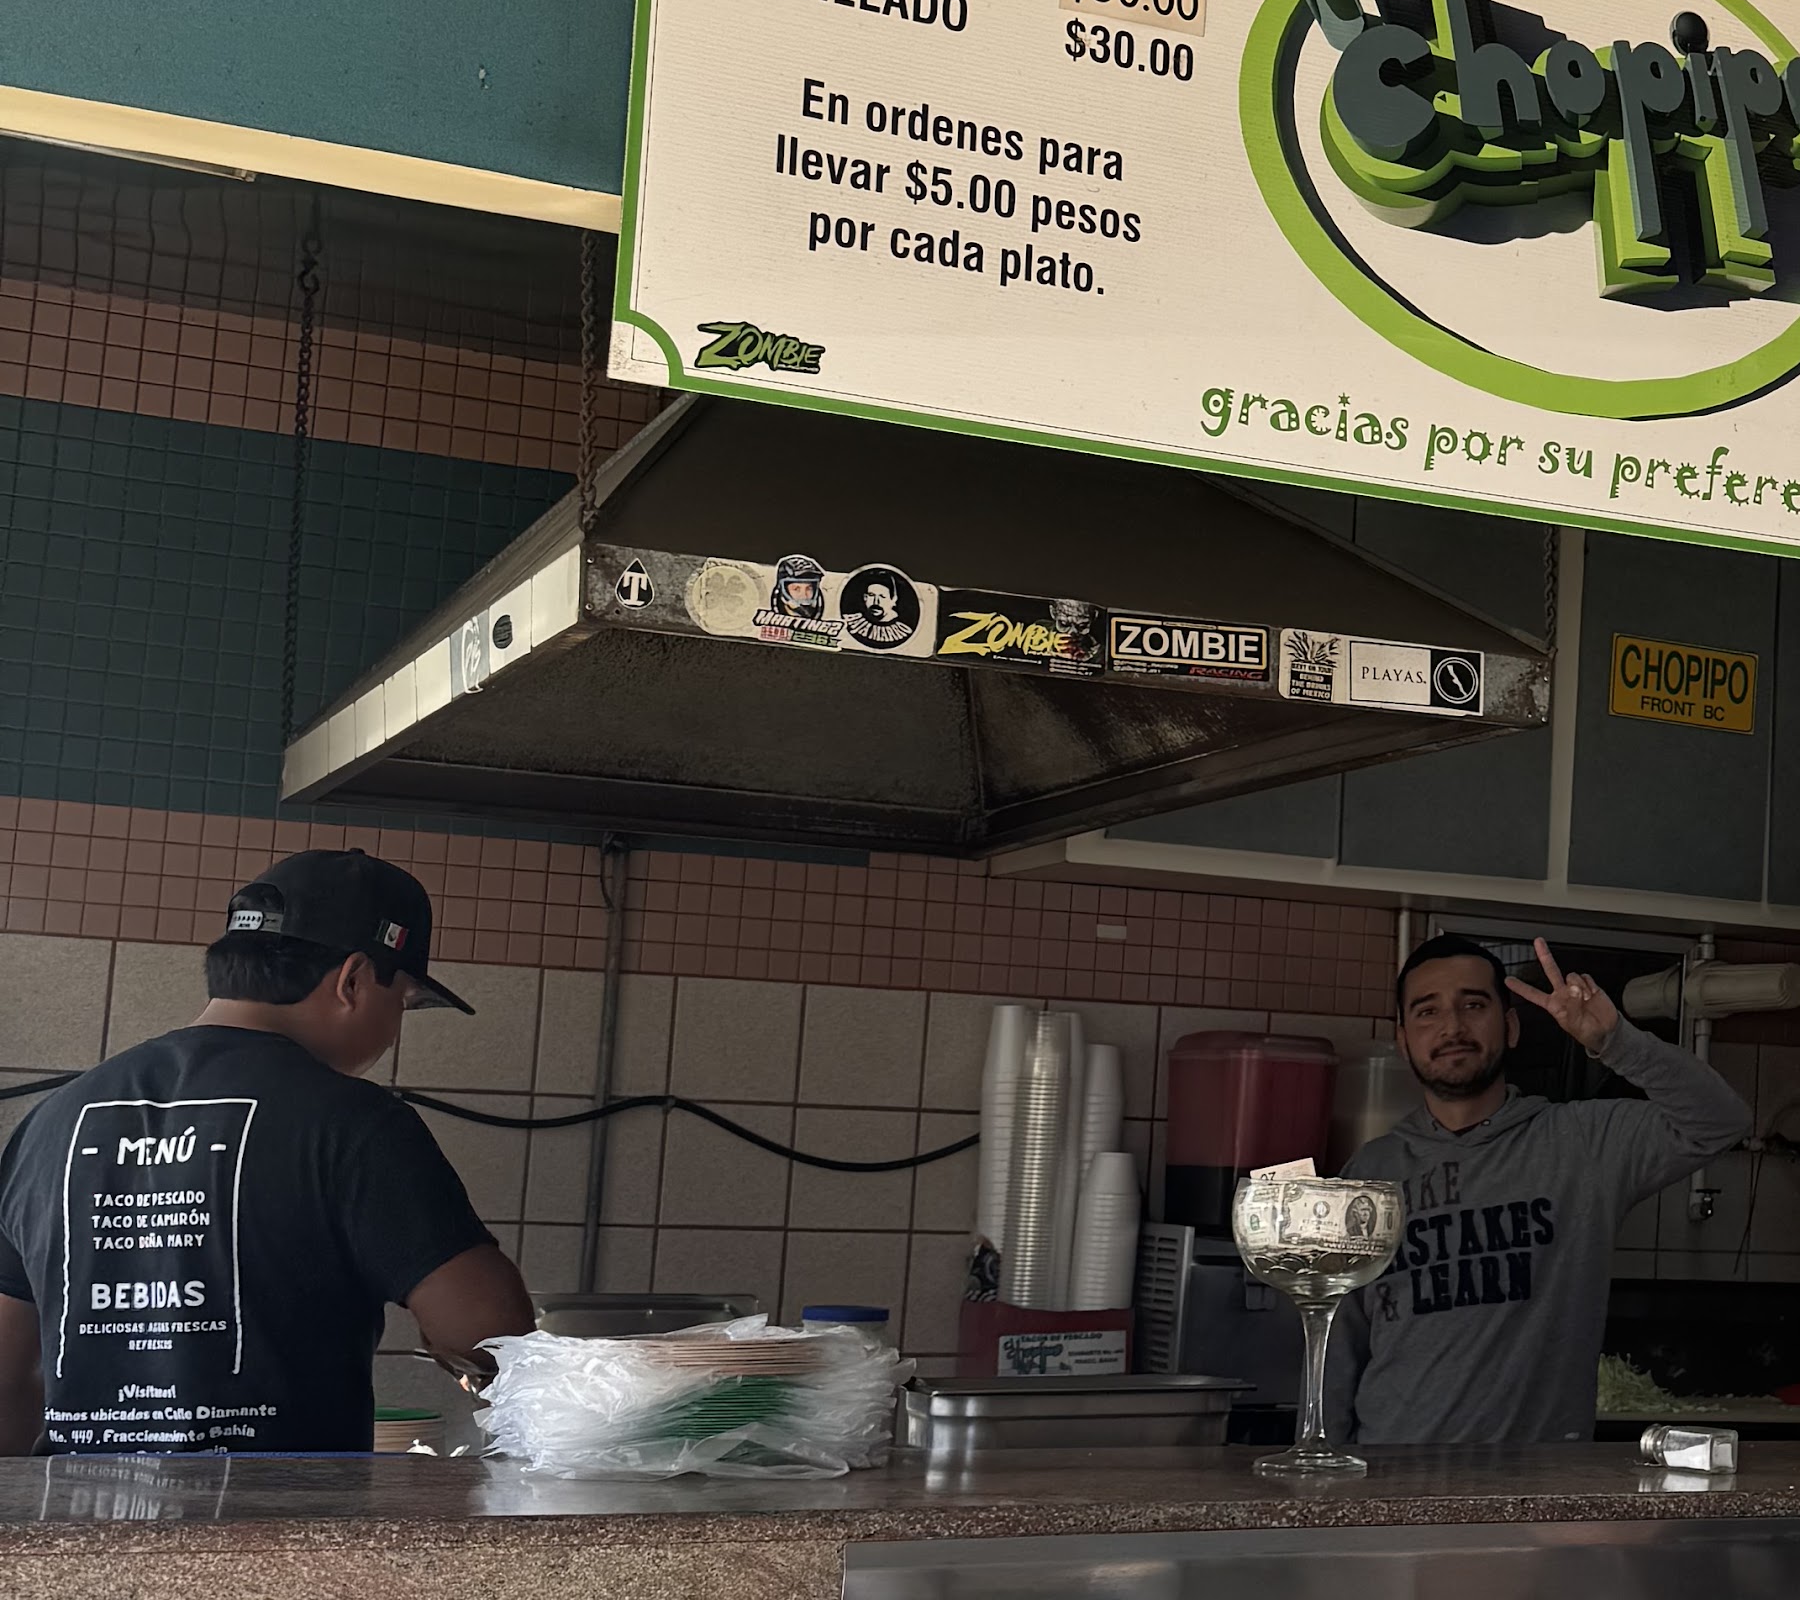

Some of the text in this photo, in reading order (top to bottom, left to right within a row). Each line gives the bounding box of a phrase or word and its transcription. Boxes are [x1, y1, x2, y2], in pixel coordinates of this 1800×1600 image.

[1065, 18, 1193, 81] $30.00
[803, 78, 1122, 181] En ordenes para
[777, 134, 1140, 242] llevar $5.00 pesos
[809, 212, 1103, 294] por cada plato.
[695, 321, 825, 374] ZOMBIE
[1200, 387, 1409, 452] gracias
[1425, 422, 1524, 471] por
[1538, 436, 1594, 478] su
[938, 611, 1070, 656] ZOMBIE
[1118, 625, 1261, 664] ZOMBIE
[1187, 666, 1264, 681] RACING
[1361, 664, 1427, 685] PLAYAS.
[1620, 644, 1748, 704] CHOPIPO
[1641, 696, 1725, 721] FRONT BC
[117, 1126, 197, 1166] MENÚ
[91, 1208, 210, 1228] TACO DE CAMARÓN
[93, 1191, 206, 1207] TACO DE PESCADO
[93, 1236, 134, 1250] TACO
[167, 1234, 204, 1248] MARY
[1384, 1197, 1554, 1275] STAKES
[91, 1280, 206, 1310] BEBIDAS
[1411, 1252, 1531, 1315] LEARN
[79, 1322, 145, 1336] DELICIOSAS
[170, 1320, 227, 1333] FRESCAS
[90, 1407, 150, 1421] ubicados
[195, 1404, 277, 1420] Diamante
[209, 1424, 256, 1439] Bahía
